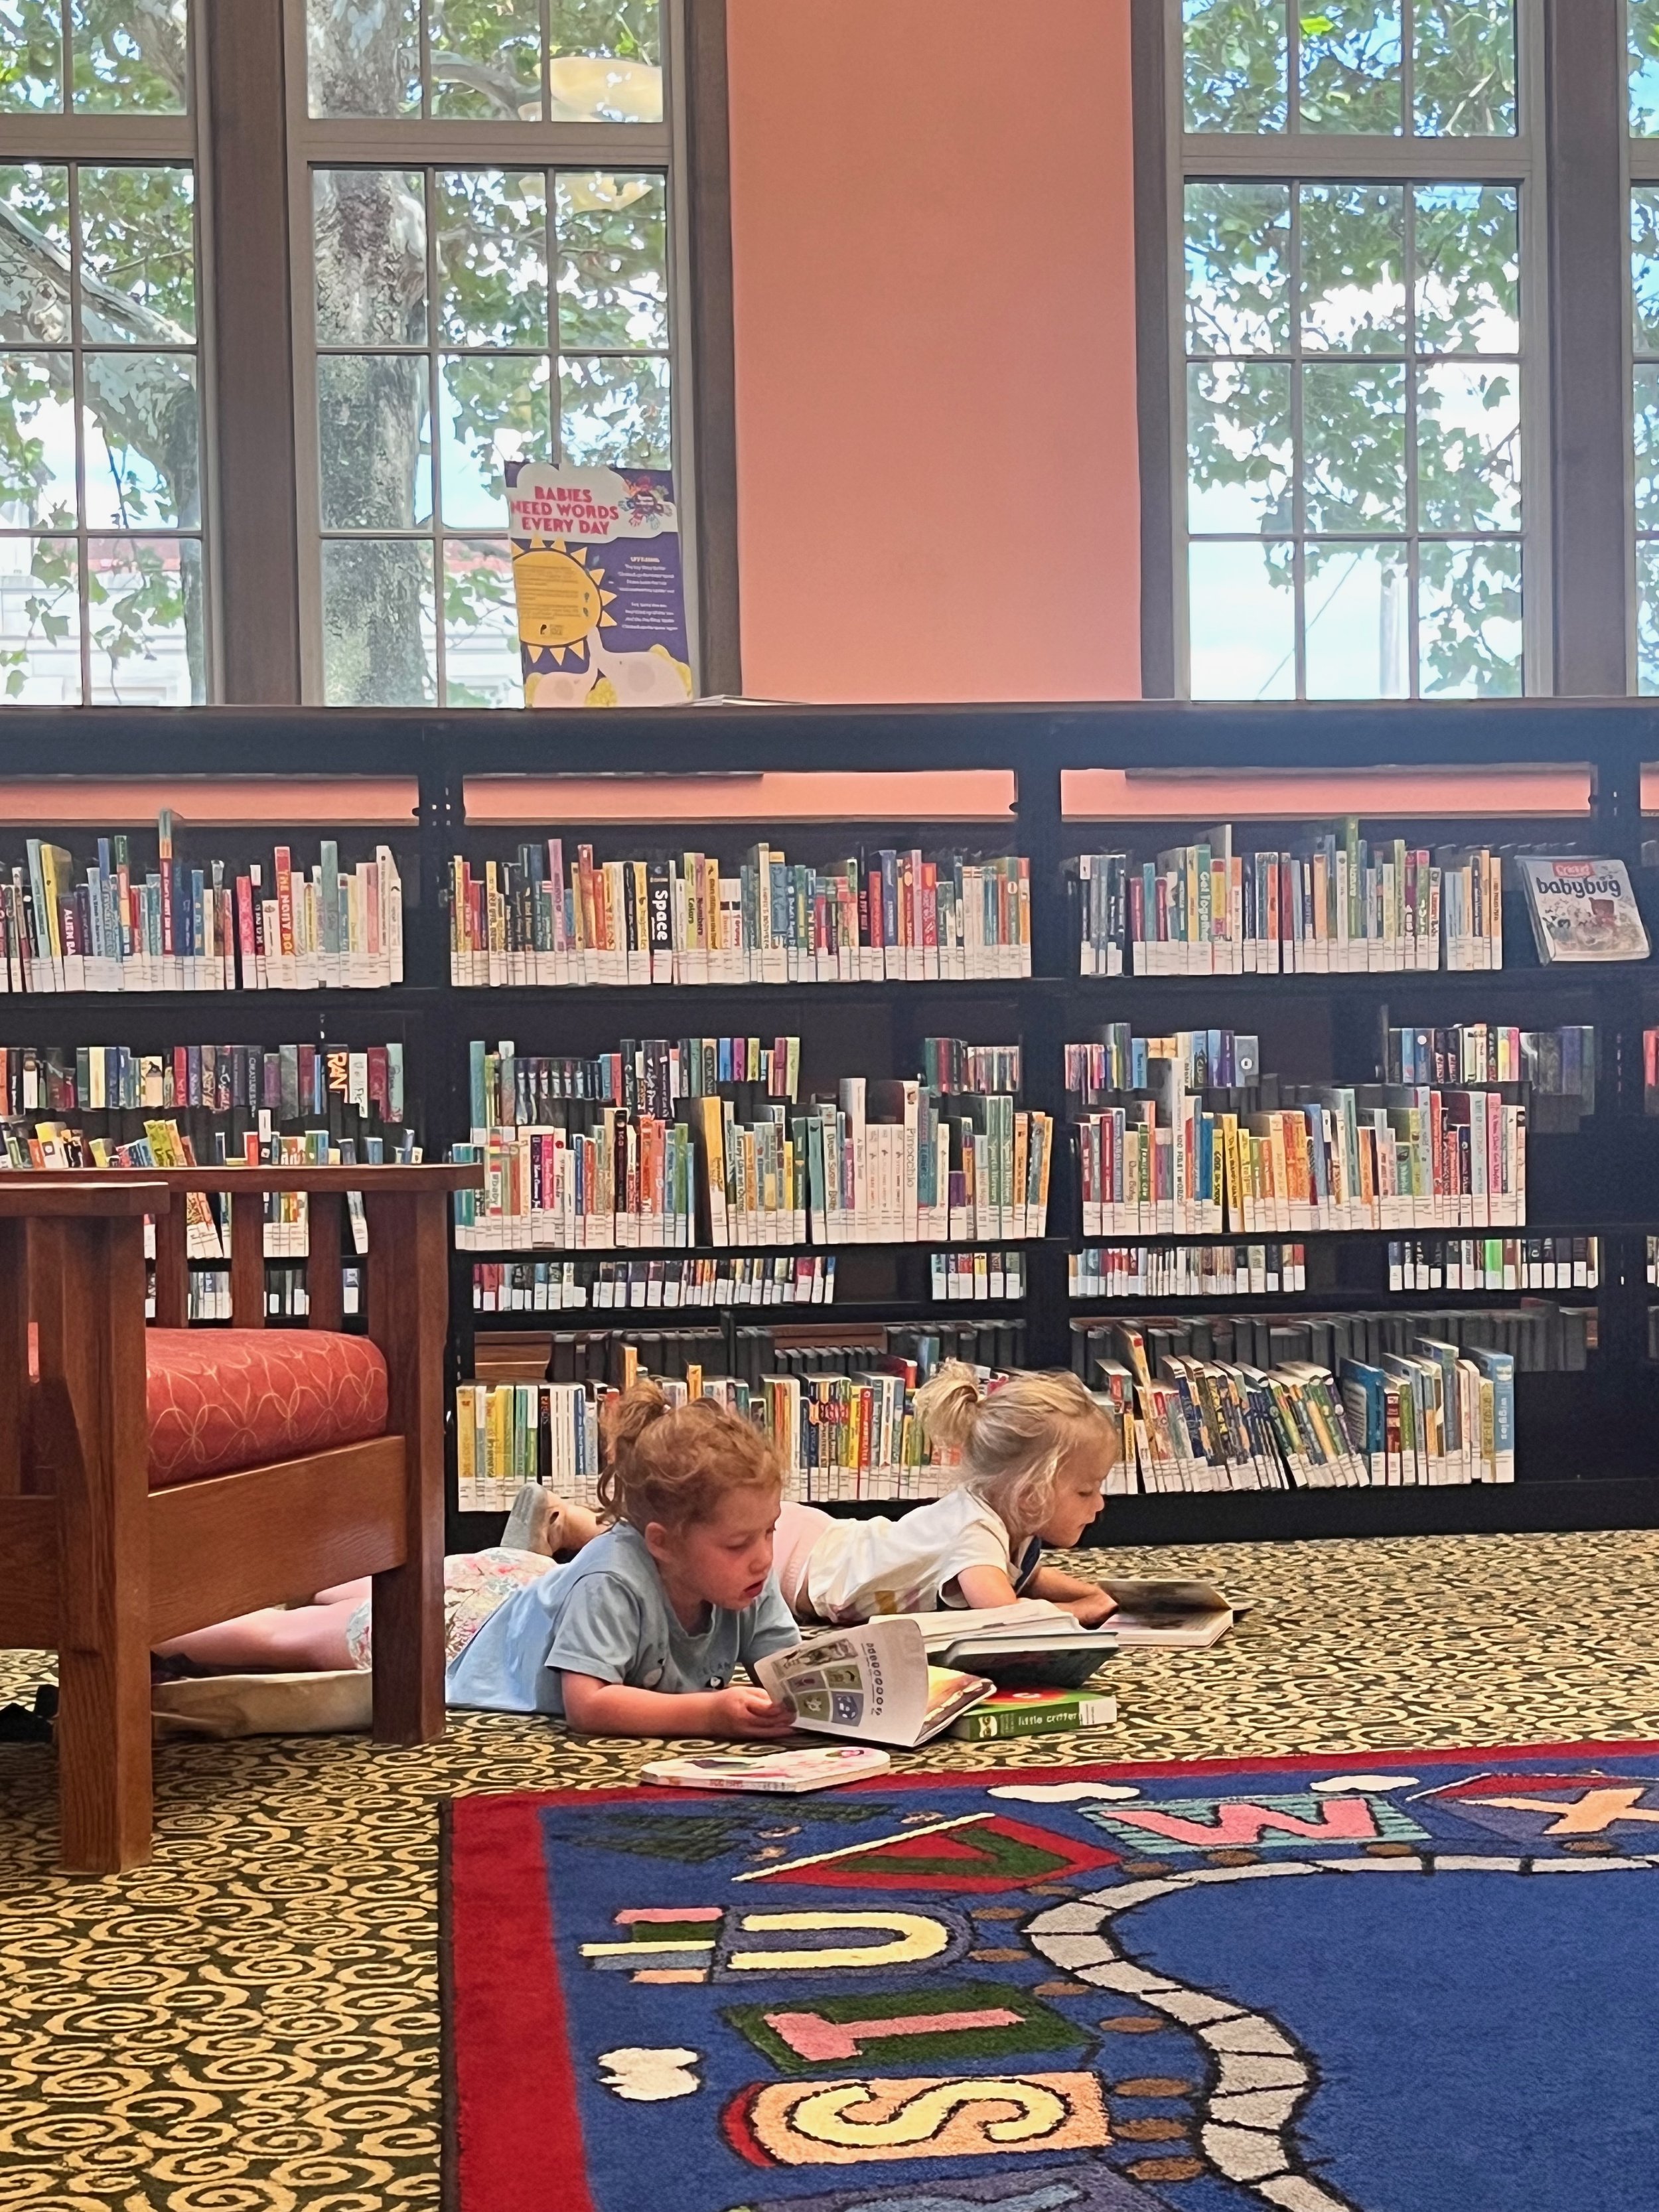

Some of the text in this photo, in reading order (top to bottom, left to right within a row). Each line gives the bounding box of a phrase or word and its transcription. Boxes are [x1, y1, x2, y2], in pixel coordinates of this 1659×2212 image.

[511, 501, 619, 520] NEED WORDS
[535, 486, 592, 502] BABIES
[522, 517, 609, 535] EVERY DAY
[1536, 875, 1621, 899] babybug
[652, 890, 668, 940] Space
[906, 1128, 916, 1187] Pinocchio
[1019, 1713, 1043, 1726] little
[1099, 1797, 1380, 1846] W
[827, 1826, 1072, 1878] V
[727, 1911, 949, 1969] U
[762, 2007, 1026, 2060] T
[792, 2080, 1066, 2146] S
